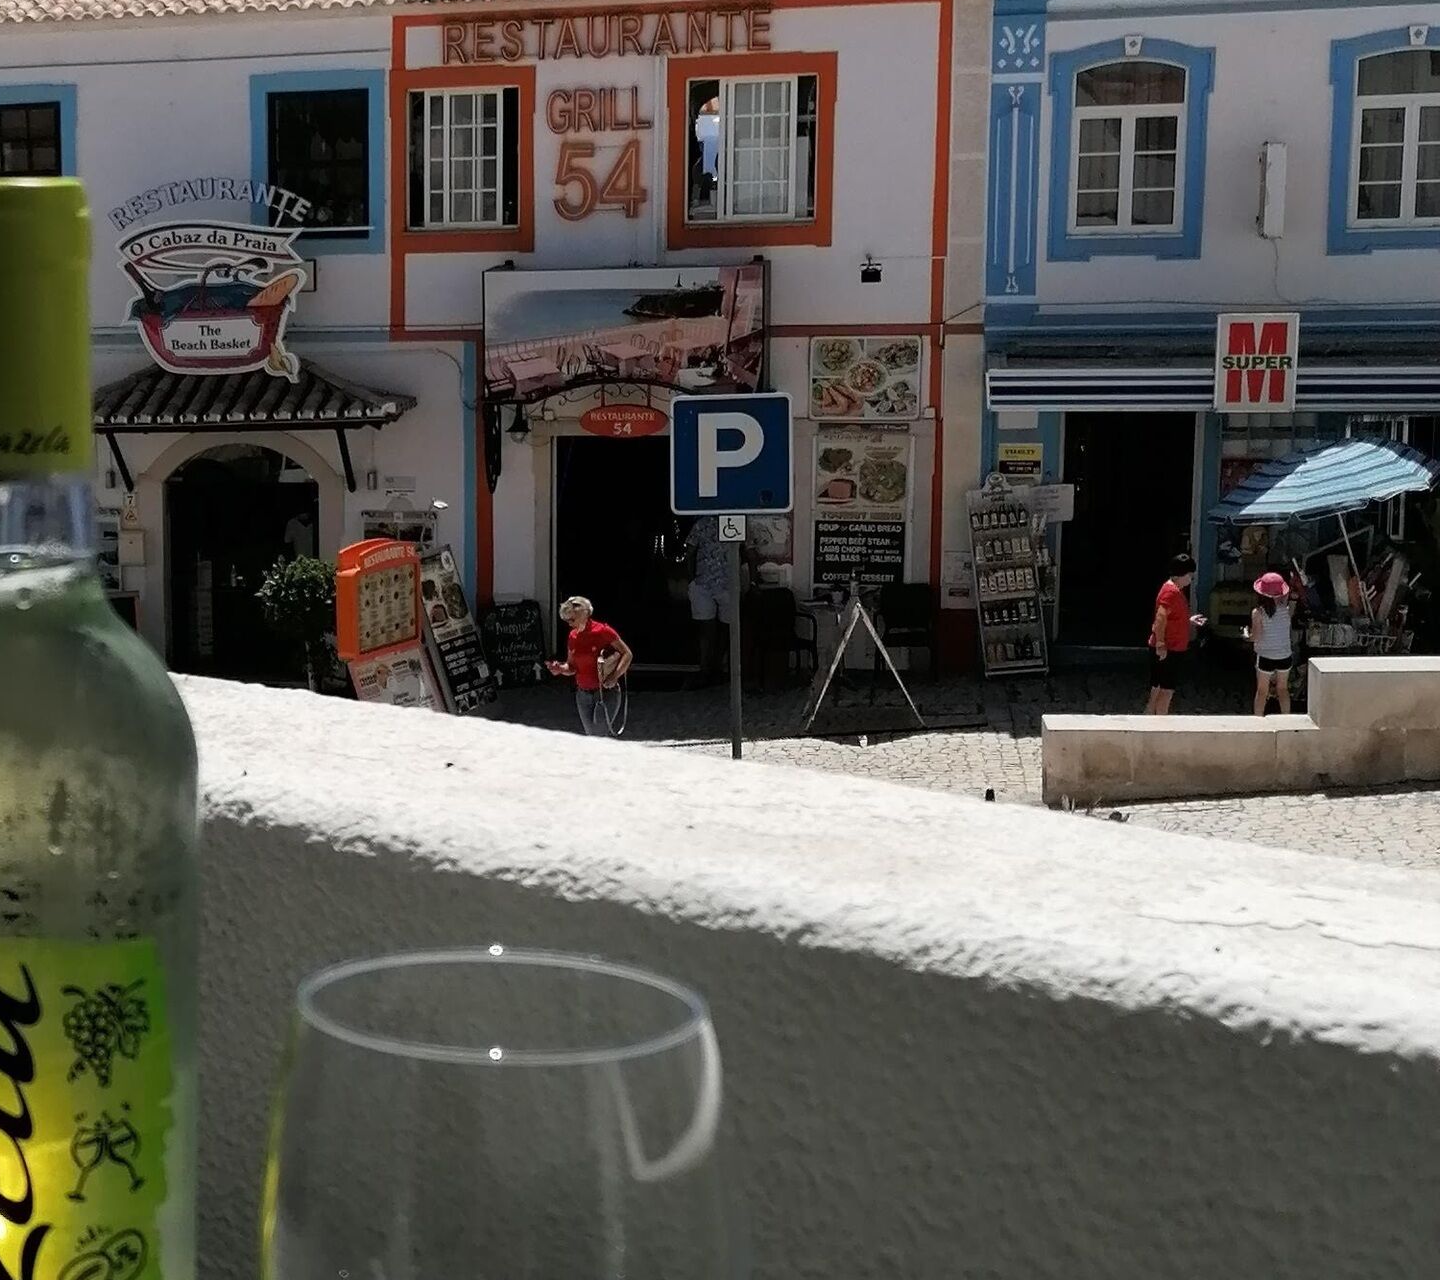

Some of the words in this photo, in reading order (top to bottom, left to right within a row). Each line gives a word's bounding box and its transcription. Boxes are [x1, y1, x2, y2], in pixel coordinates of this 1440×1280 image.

[442, 9, 772, 65] RESTAURANTE
[545, 86, 652, 135] GRILL
[553, 138, 647, 221] 54
[108, 177, 311, 232] RESTAURANTE
[129, 242, 144, 257] O
[148, 231, 201, 249] Cabaz
[207, 230, 227, 246] da
[233, 232, 278, 252] Praia
[198, 325, 221, 336] The
[171, 339, 208, 351] Beach
[210, 338, 251, 350] Basket
[1222, 355, 1293, 370] SUPER
[590, 411, 656, 421] RESTAURANTE
[612, 422, 632, 436] 54
[698, 412, 764, 497] P
[818, 523, 840, 532] SOUP
[848, 524, 876, 532] GARLIC
[877, 524, 902, 533] BREAD
[820, 536, 847, 545] PEPPER
[867, 537, 891, 546] STEAK
[825, 554, 839, 562] SEA
[840, 554, 860, 562] BASS
[870, 555, 902, 563] SALMON
[860, 574, 895, 582] DESSERT
